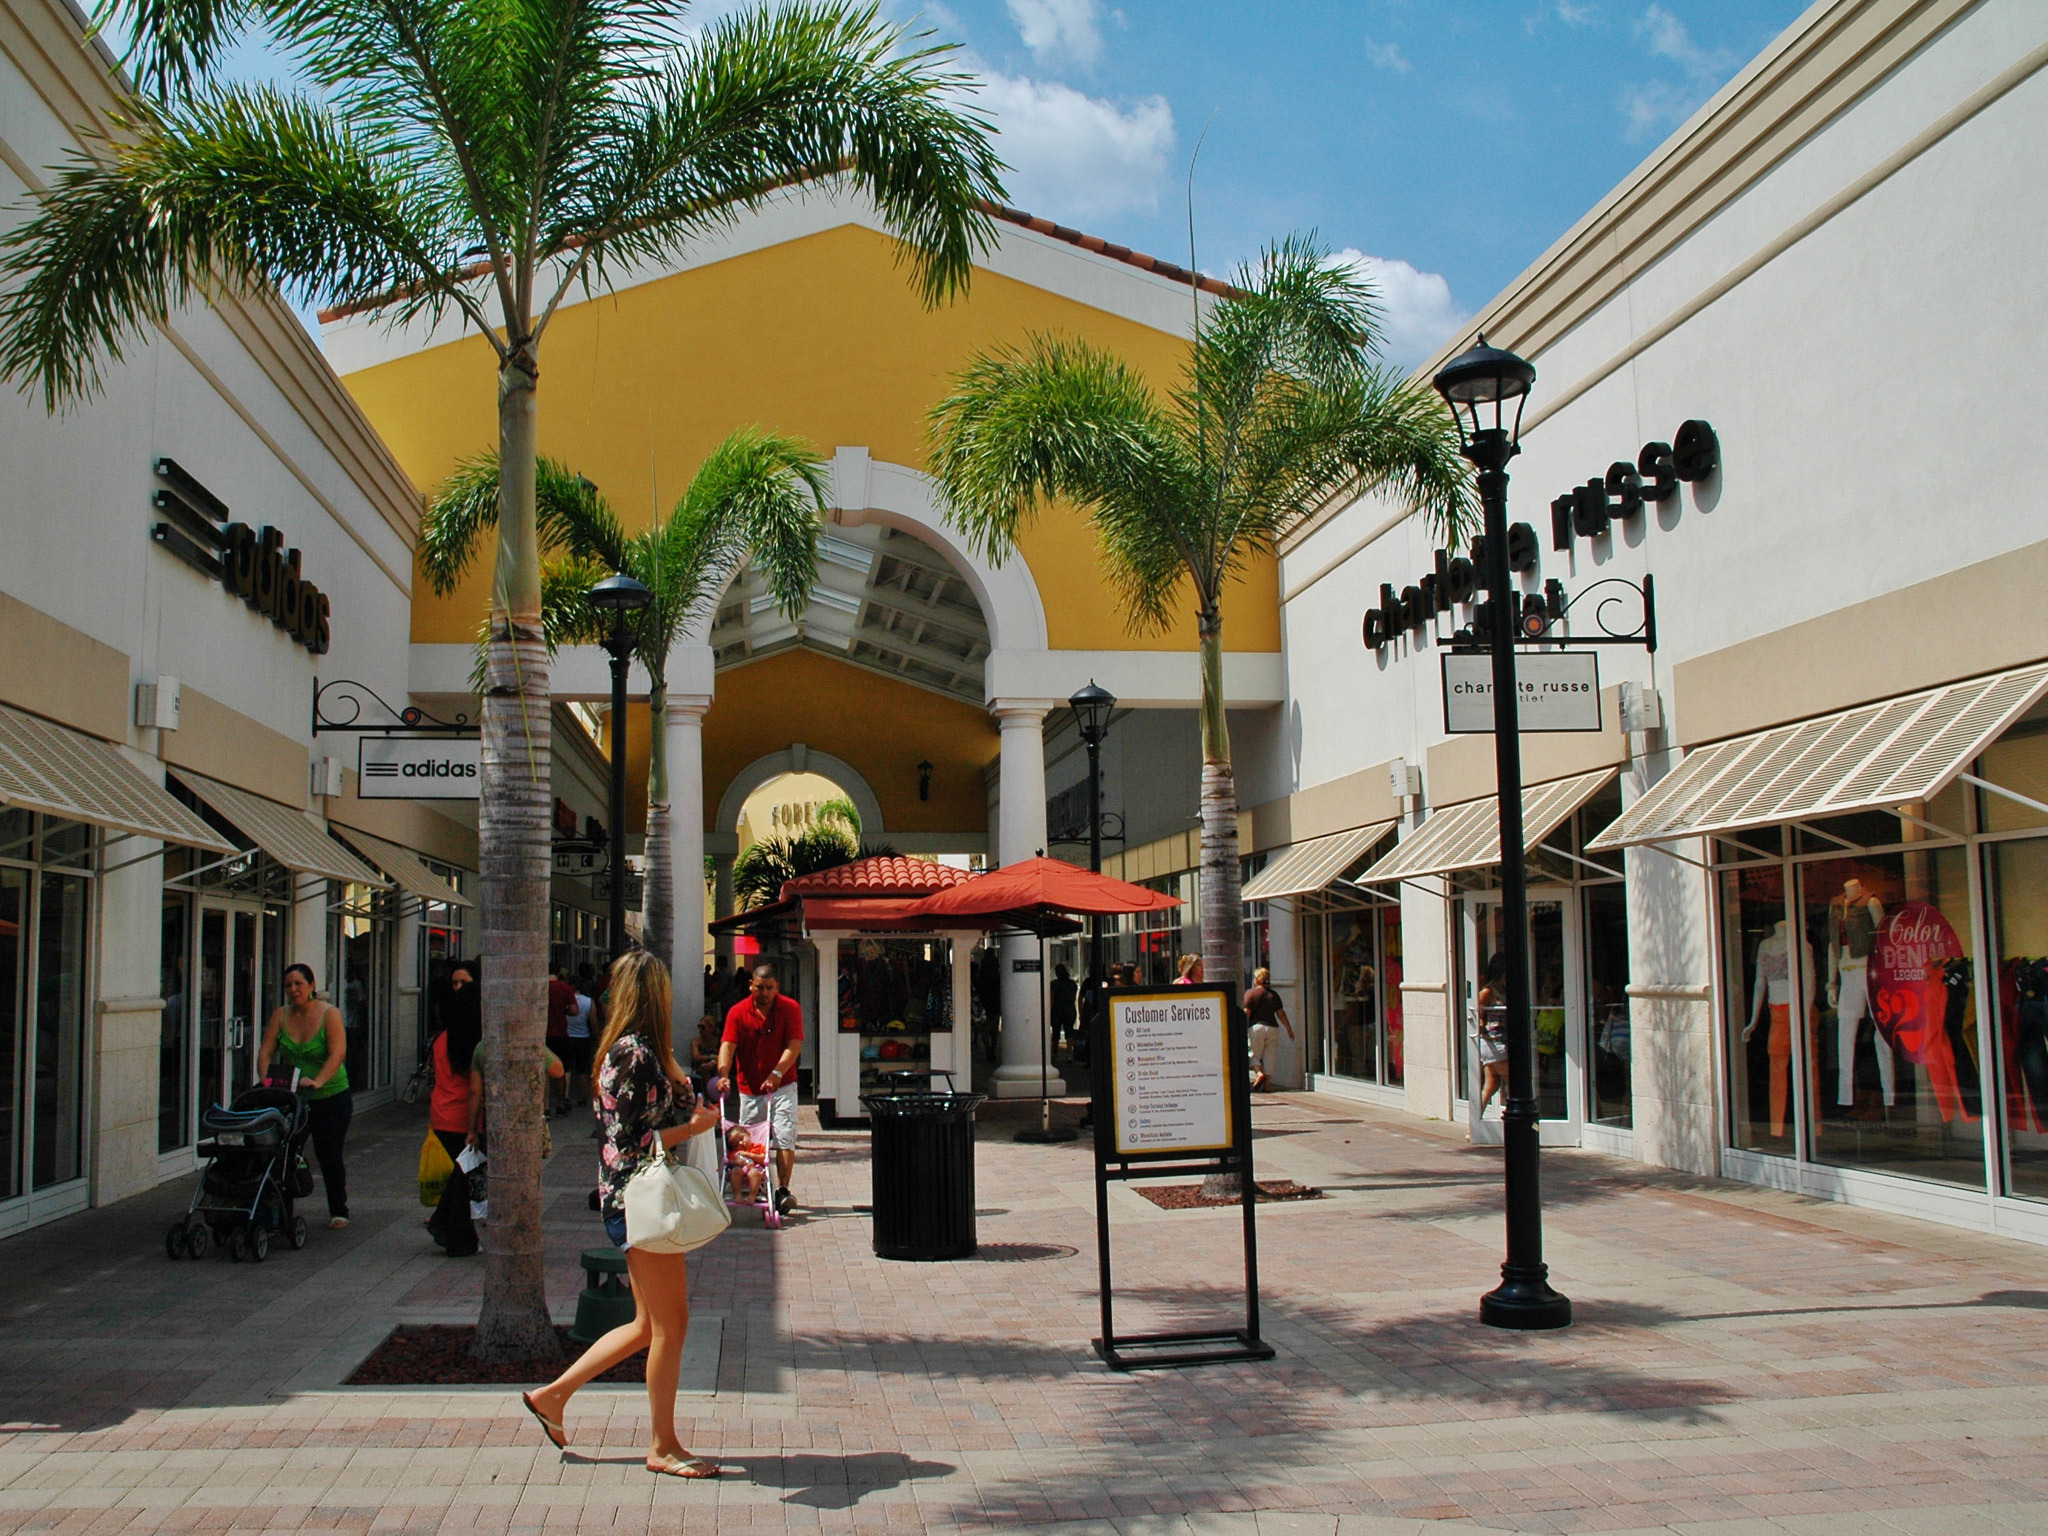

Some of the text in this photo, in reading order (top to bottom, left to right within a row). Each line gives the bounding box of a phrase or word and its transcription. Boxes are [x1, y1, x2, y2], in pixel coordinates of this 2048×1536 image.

[1551, 419, 1717, 552] russe
[225, 522, 330, 654] adidas
[1454, 681, 1590, 694] charte russe
[402, 759, 477, 778] adidas
[1888, 906, 1946, 948] Color
[1882, 943, 1946, 969] DENIM
[1893, 969, 1928, 981] LEGGIN
[1125, 1004, 1211, 1024] Customer Services
[1876, 988, 1922, 1053] $2
